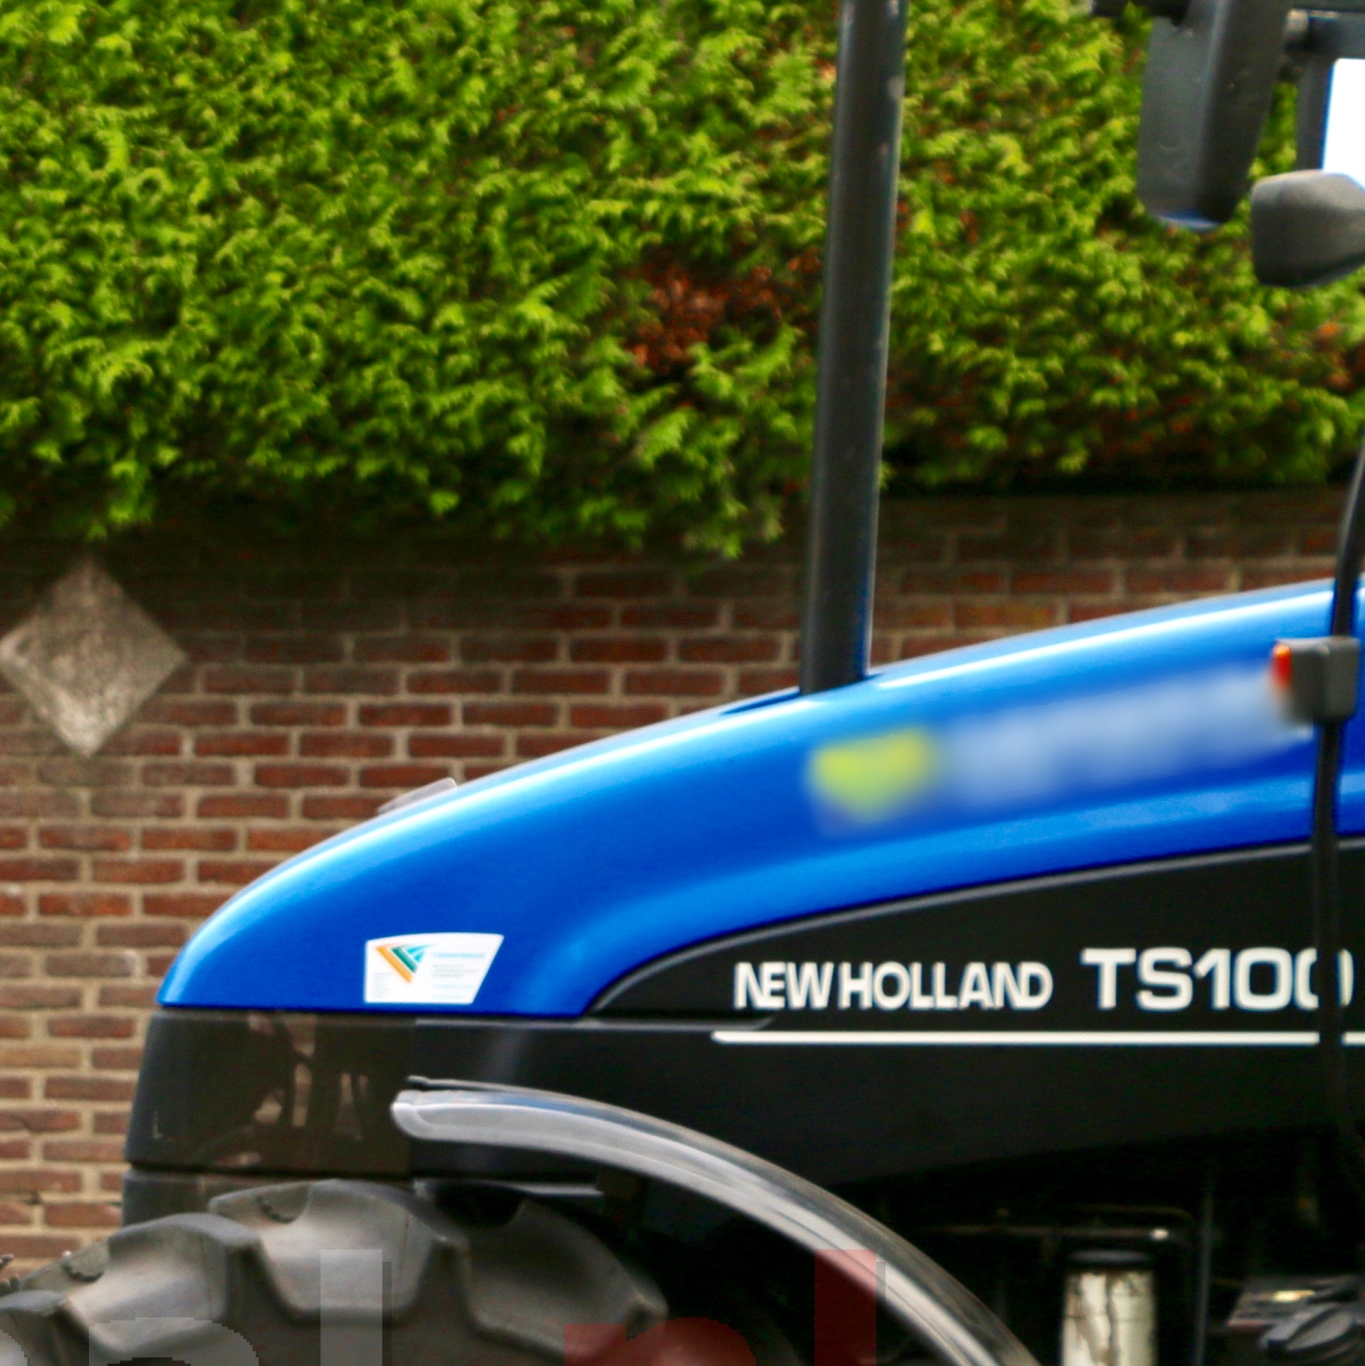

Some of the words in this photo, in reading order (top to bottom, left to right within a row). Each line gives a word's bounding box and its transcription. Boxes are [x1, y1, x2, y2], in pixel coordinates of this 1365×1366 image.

[734, 961, 834, 1010] NEW
[838, 961, 1053, 1010] HOLLAND
[1080, 947, 1354, 1011] TS100
